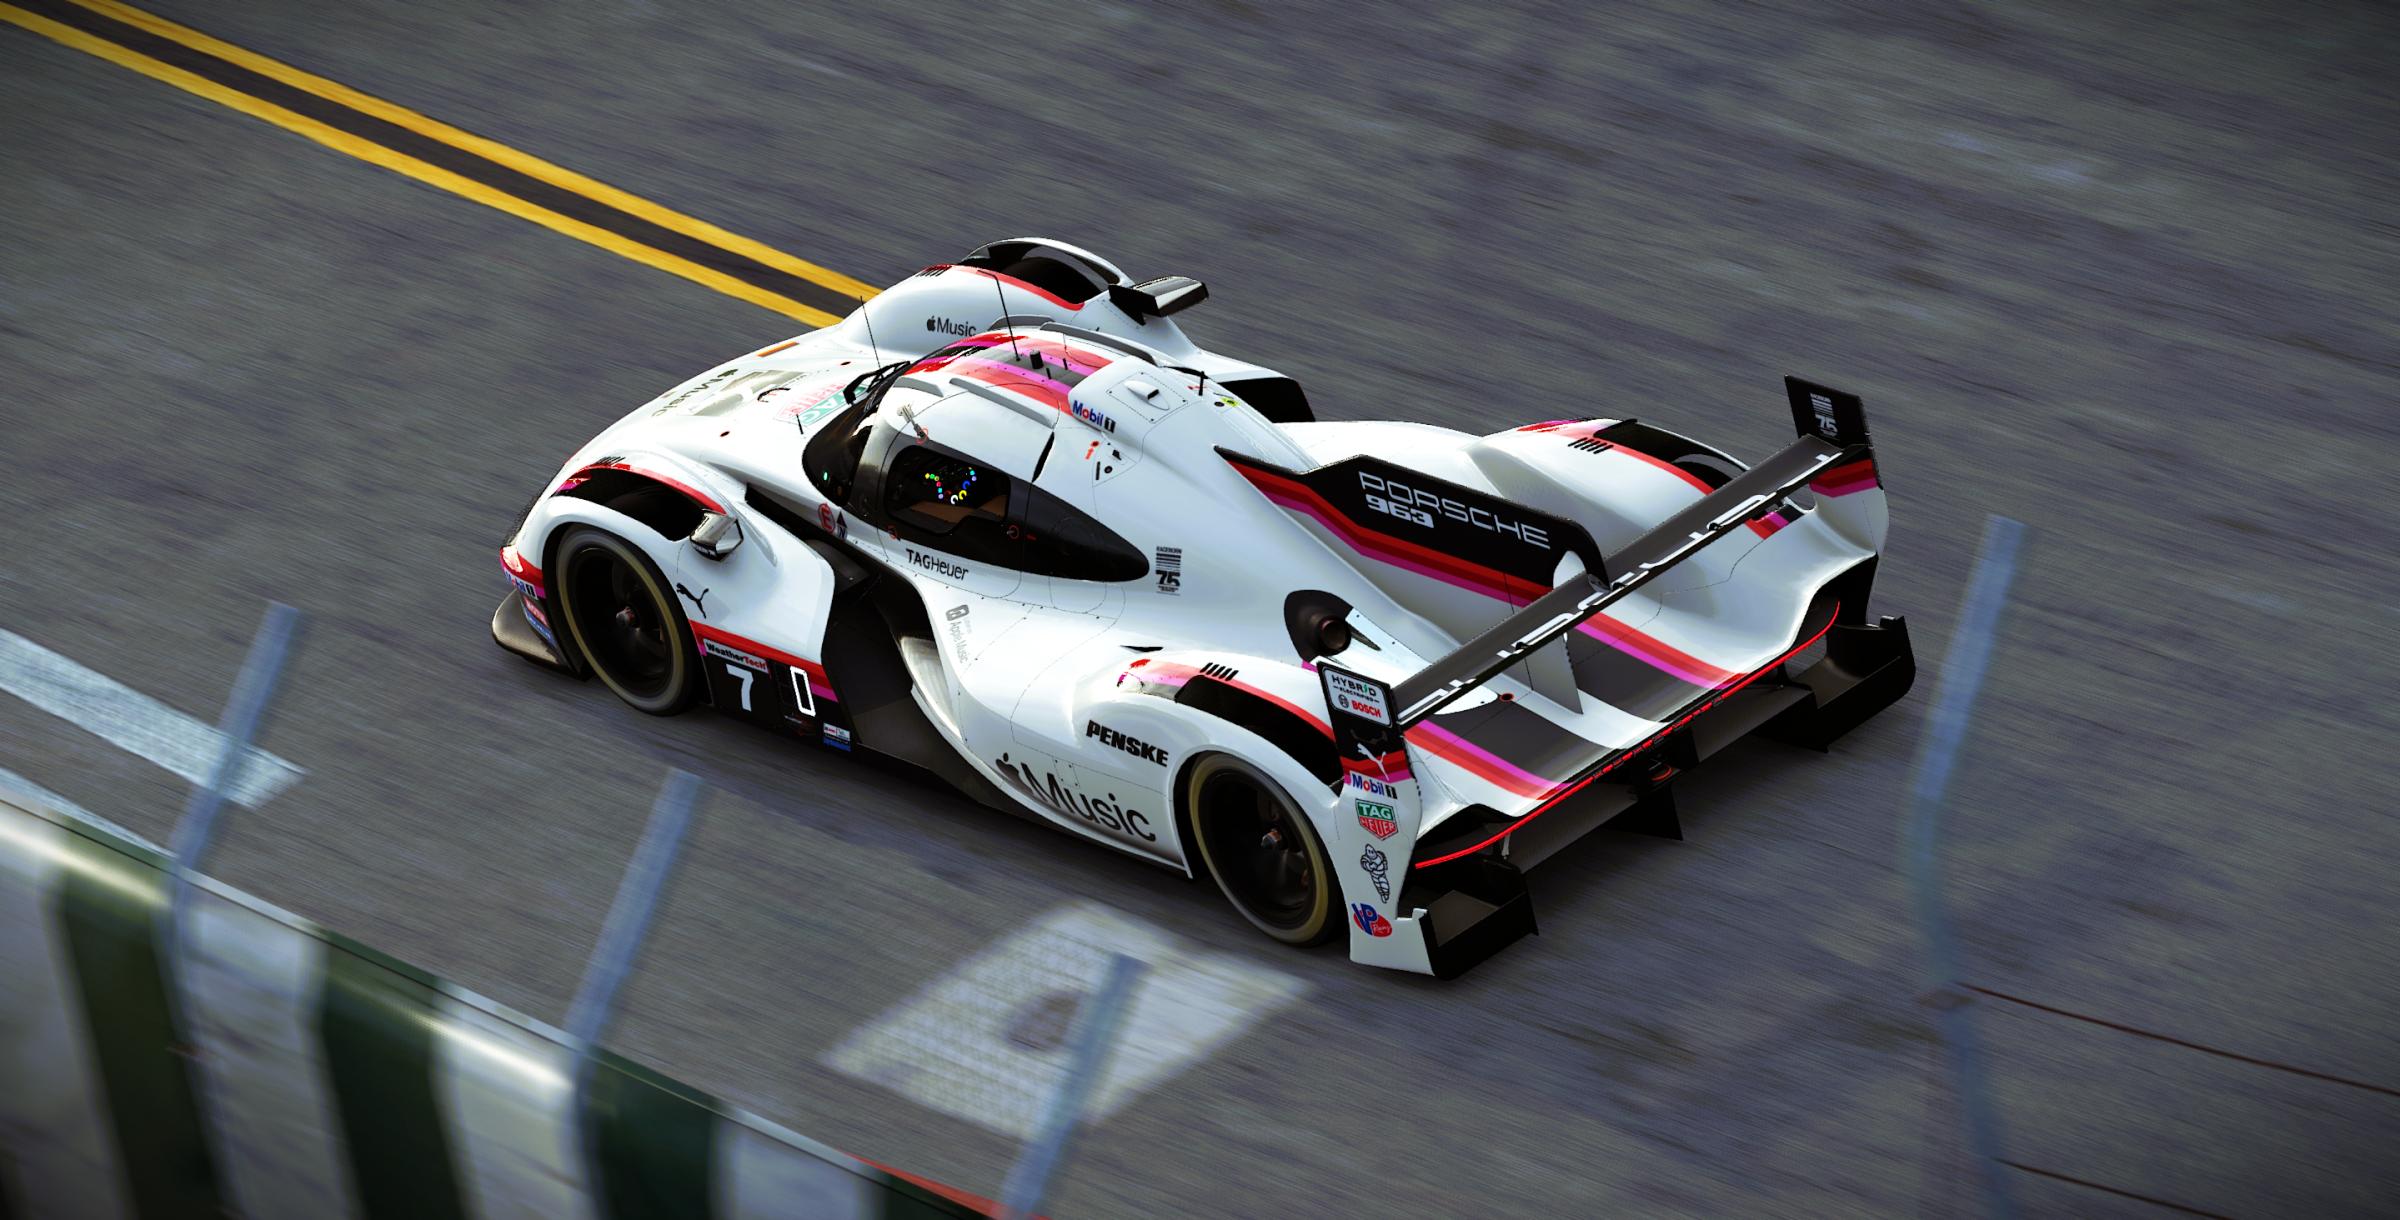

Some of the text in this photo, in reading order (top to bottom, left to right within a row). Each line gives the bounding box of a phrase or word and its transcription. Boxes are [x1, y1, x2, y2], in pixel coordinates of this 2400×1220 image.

[937, 317, 977, 337] Music
[1072, 400, 1104, 428] Mobil
[1815, 414, 1838, 432] 75
[1358, 471, 1551, 550] PORSCHE
[1365, 494, 1435, 529] 963
[1155, 569, 1181, 587] 75
[705, 642, 767, 671] WeatherTech
[726, 663, 754, 712] 7
[1332, 674, 1377, 697] HYBRID
[1351, 699, 1382, 718] BOSCH
[1086, 719, 1169, 768] PENSKE
[1352, 772, 1385, 796] Mobil
[1020, 762, 1157, 842] Music
[1358, 803, 1392, 820] TAG
[1360, 816, 1395, 837] HEUER
[1351, 902, 1378, 936] VP
